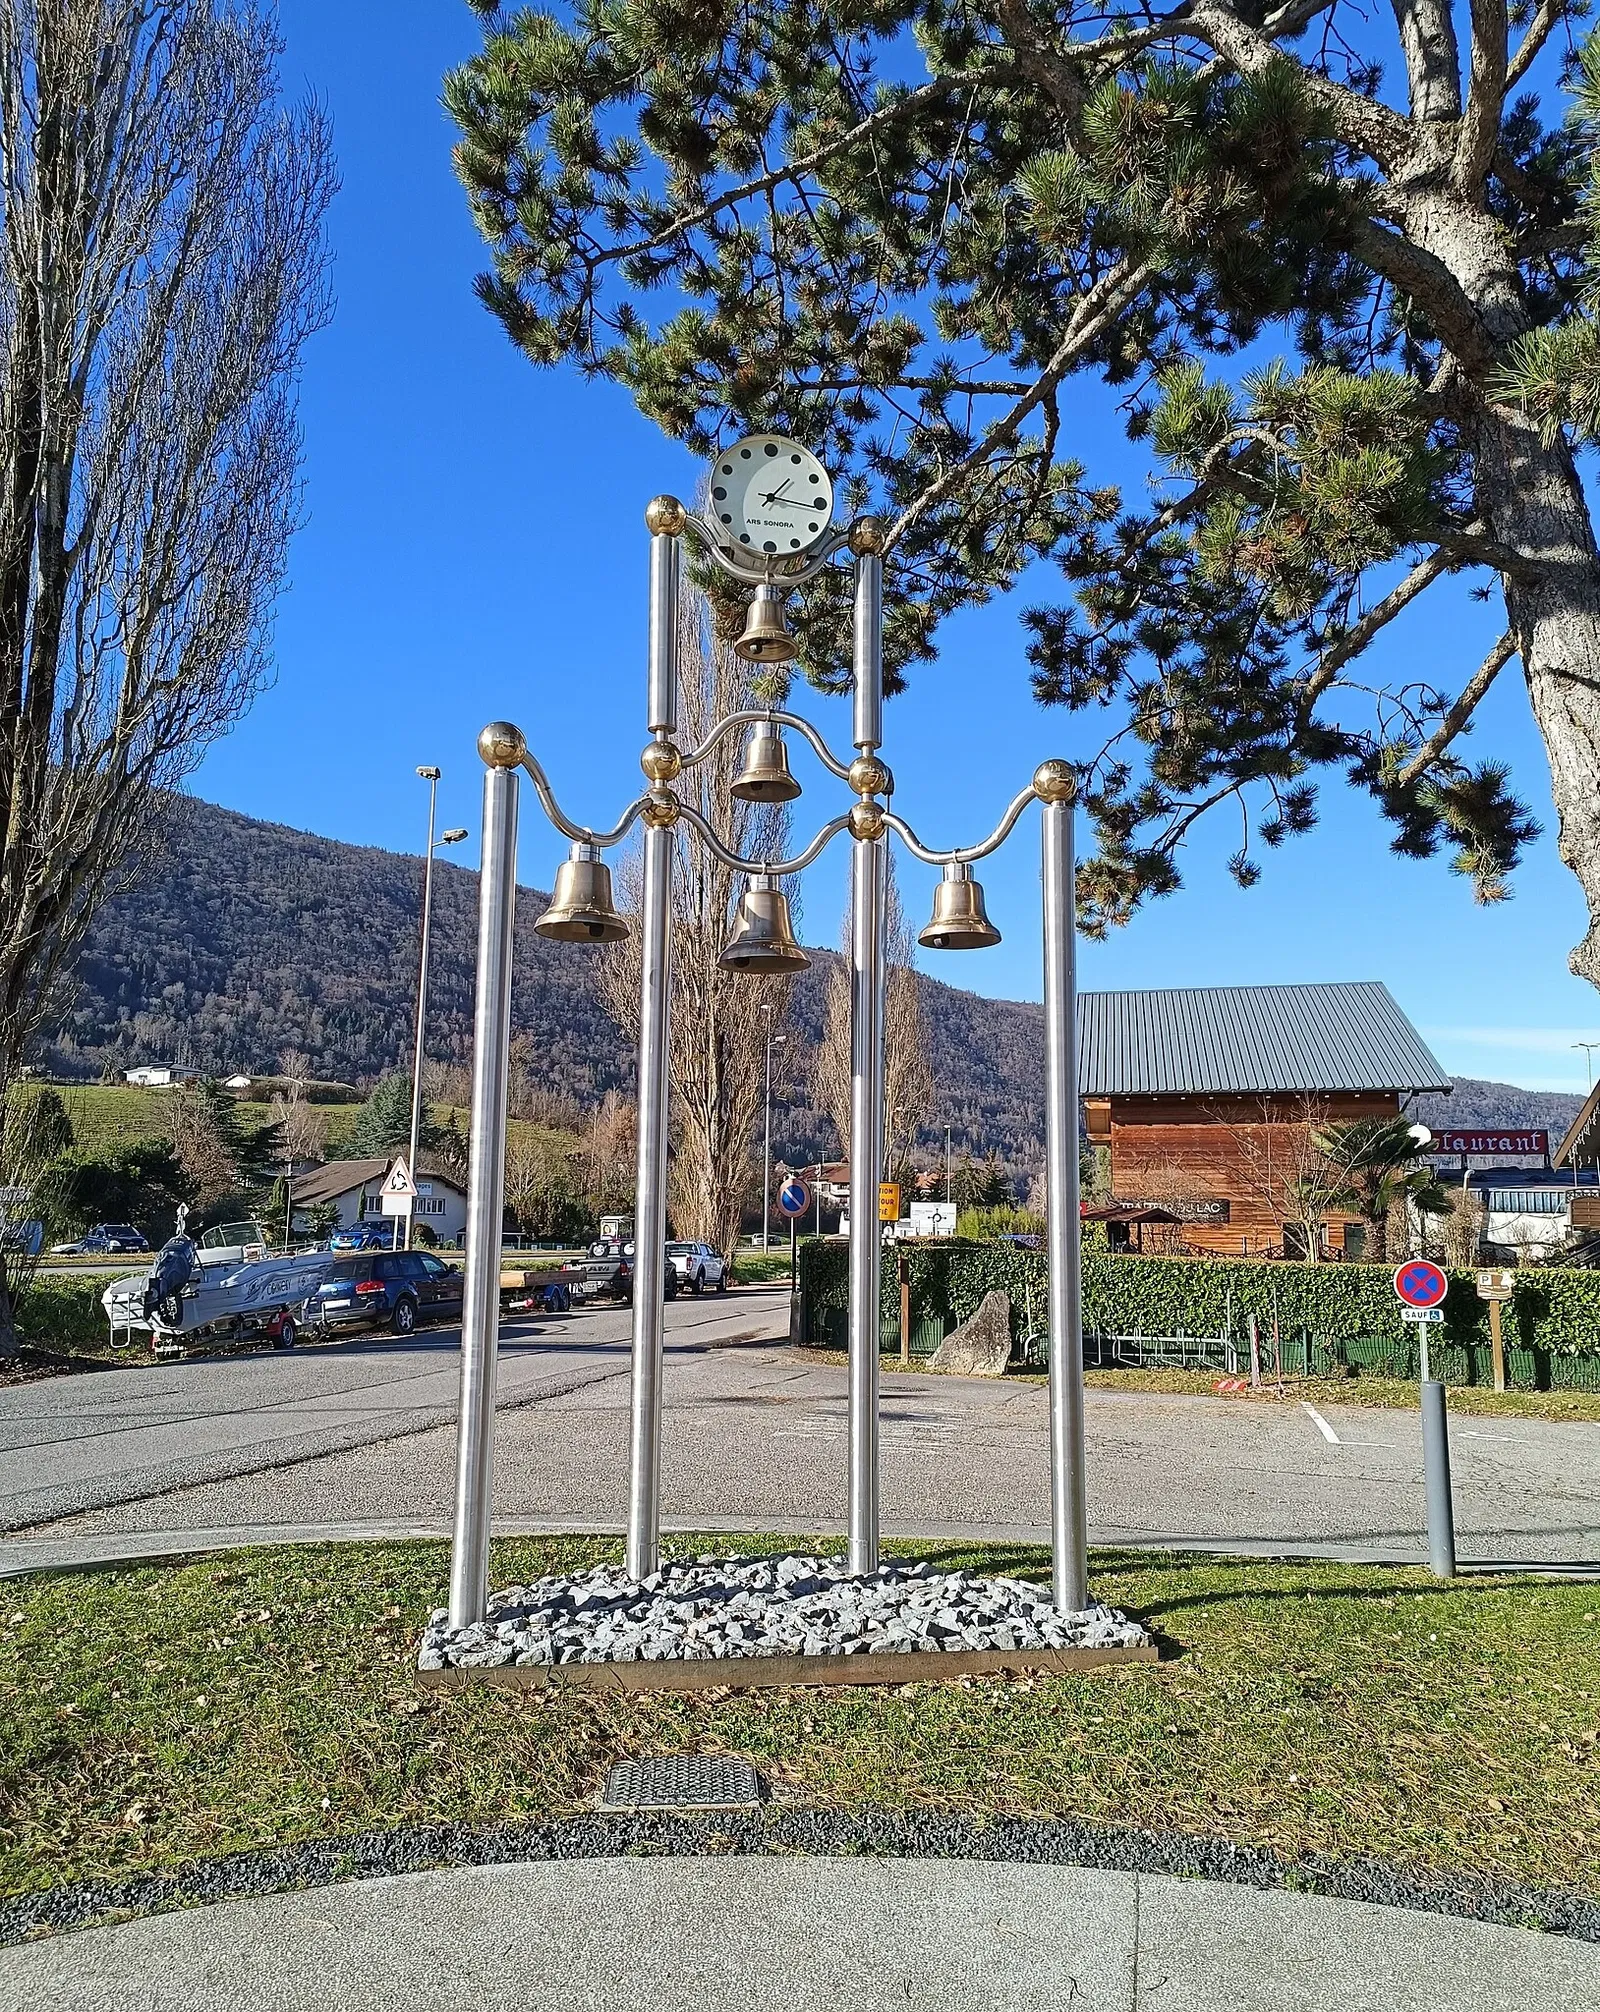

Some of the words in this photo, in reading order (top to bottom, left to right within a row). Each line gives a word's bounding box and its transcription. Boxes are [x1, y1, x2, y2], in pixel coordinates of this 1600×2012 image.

[763, 519, 794, 529] SONORA
[1431, 1131, 1541, 1152] staurant
[1196, 1202, 1221, 1213] LAC
[1404, 1310, 1428, 1319] SAUF
